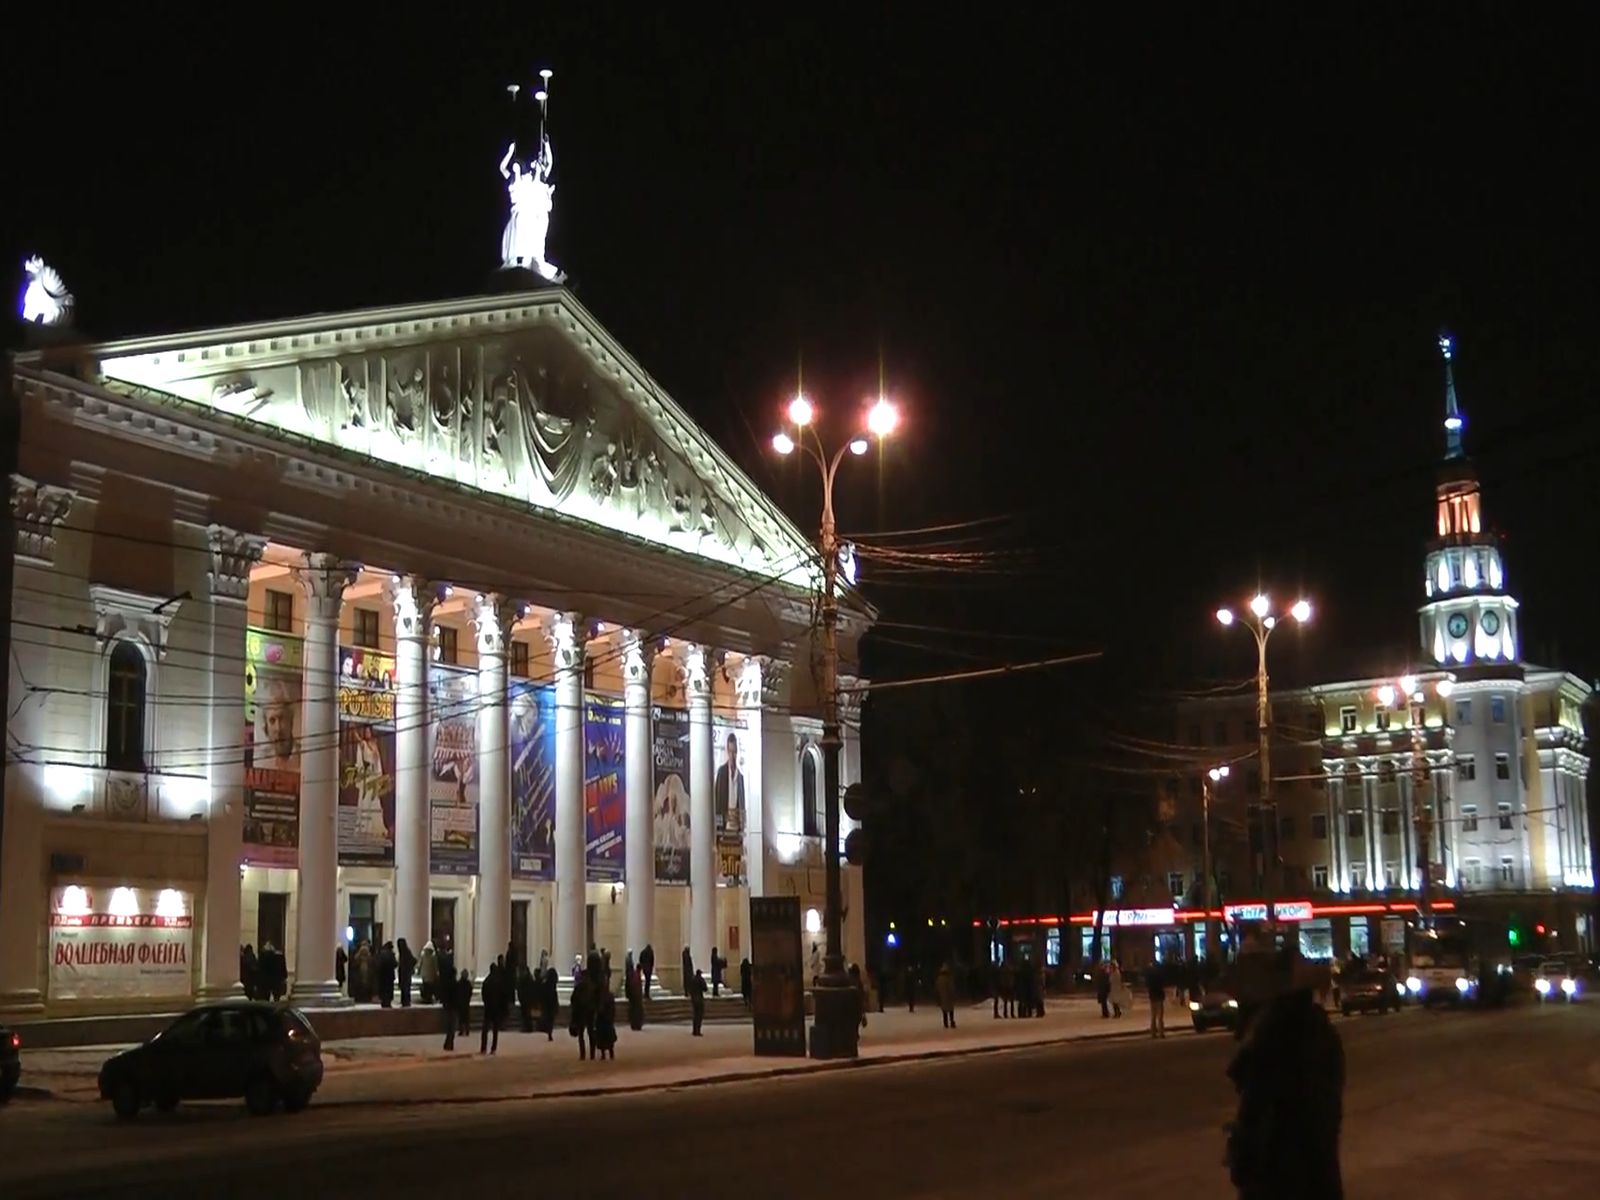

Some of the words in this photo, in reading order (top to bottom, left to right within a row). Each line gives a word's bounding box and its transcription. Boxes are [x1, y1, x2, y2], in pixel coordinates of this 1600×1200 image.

[91, 915, 157, 926] ПРЕМЬЕРА
[55, 942, 136, 967] ВОЛШЕБНАЯ
[138, 938, 186, 965] ФЛЕЙТА
